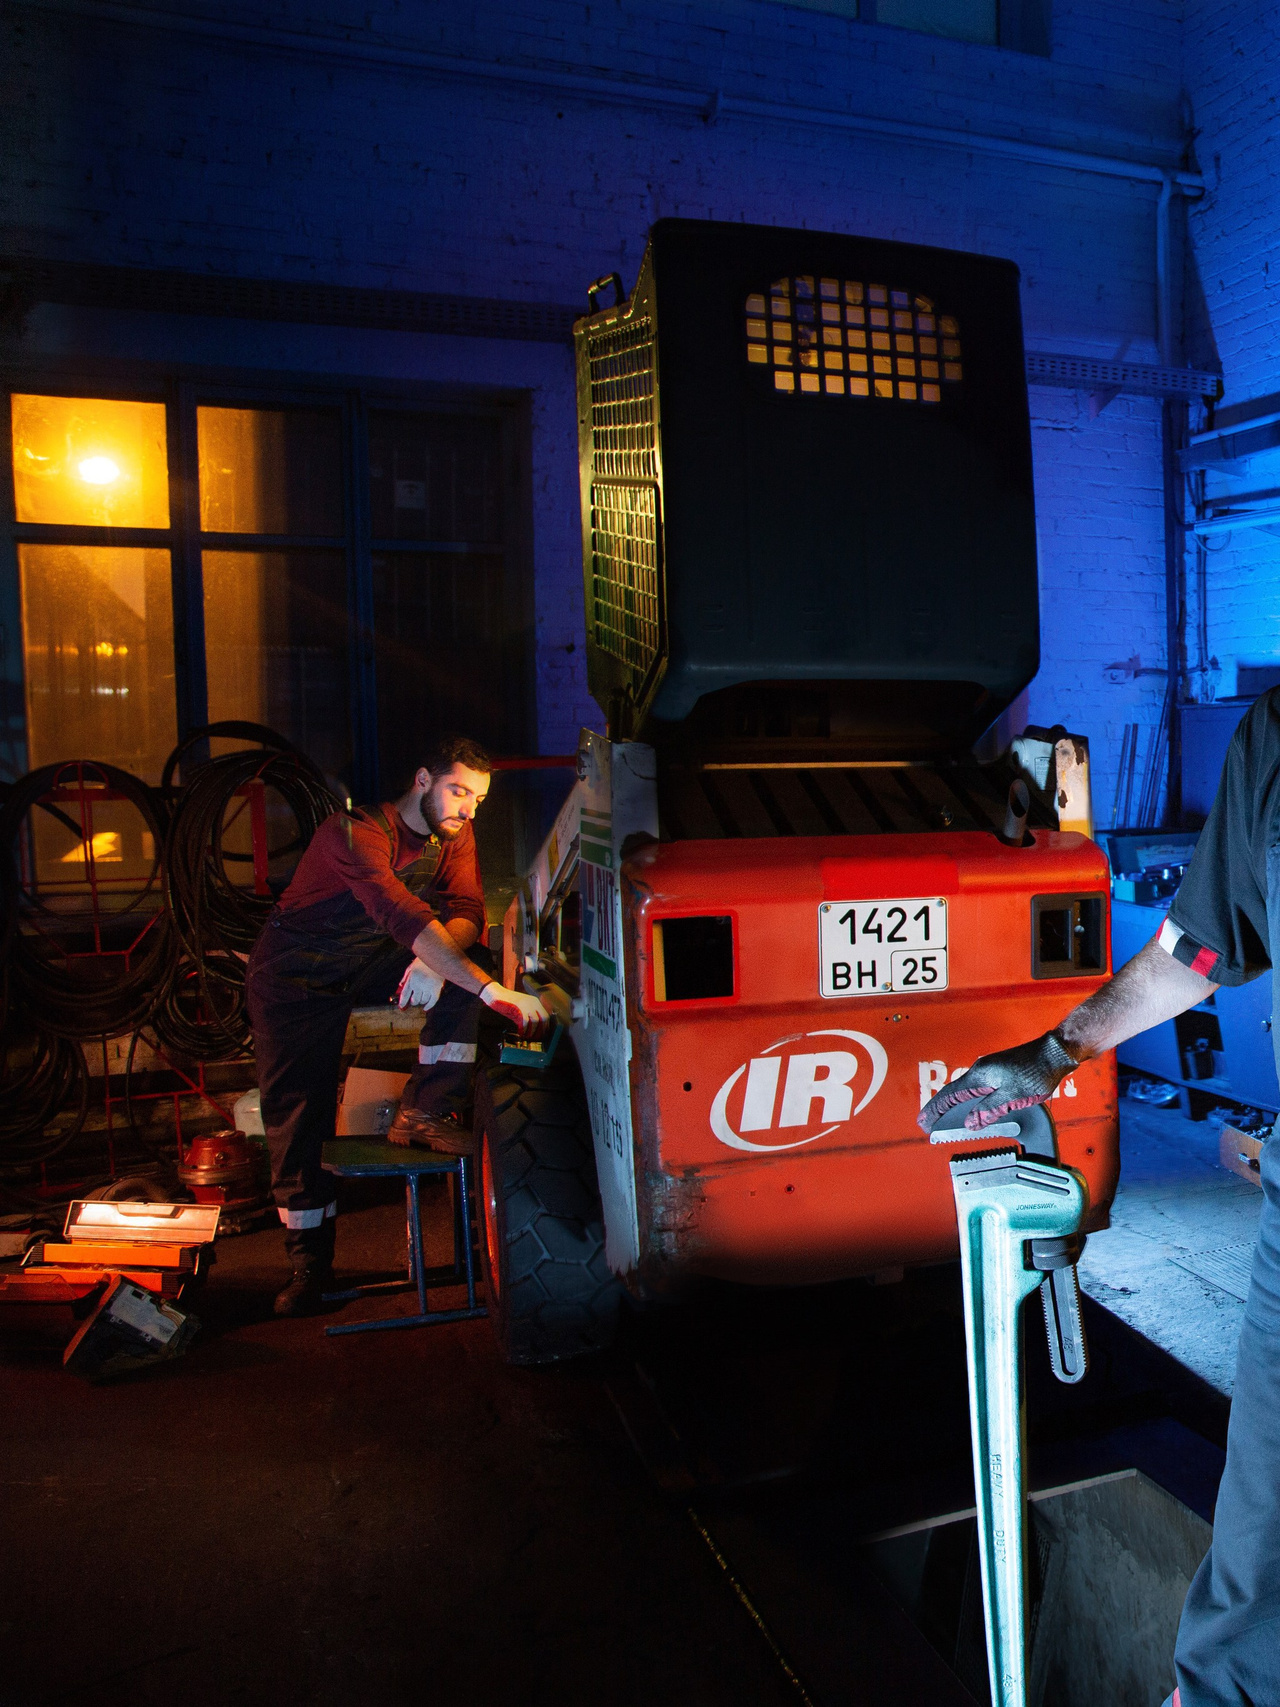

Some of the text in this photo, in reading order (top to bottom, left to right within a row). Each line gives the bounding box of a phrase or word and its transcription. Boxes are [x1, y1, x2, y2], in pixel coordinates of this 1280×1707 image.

[838, 905, 930, 945] 1421
[902, 956, 938, 985] 25
[739, 1050, 858, 1132] IR
